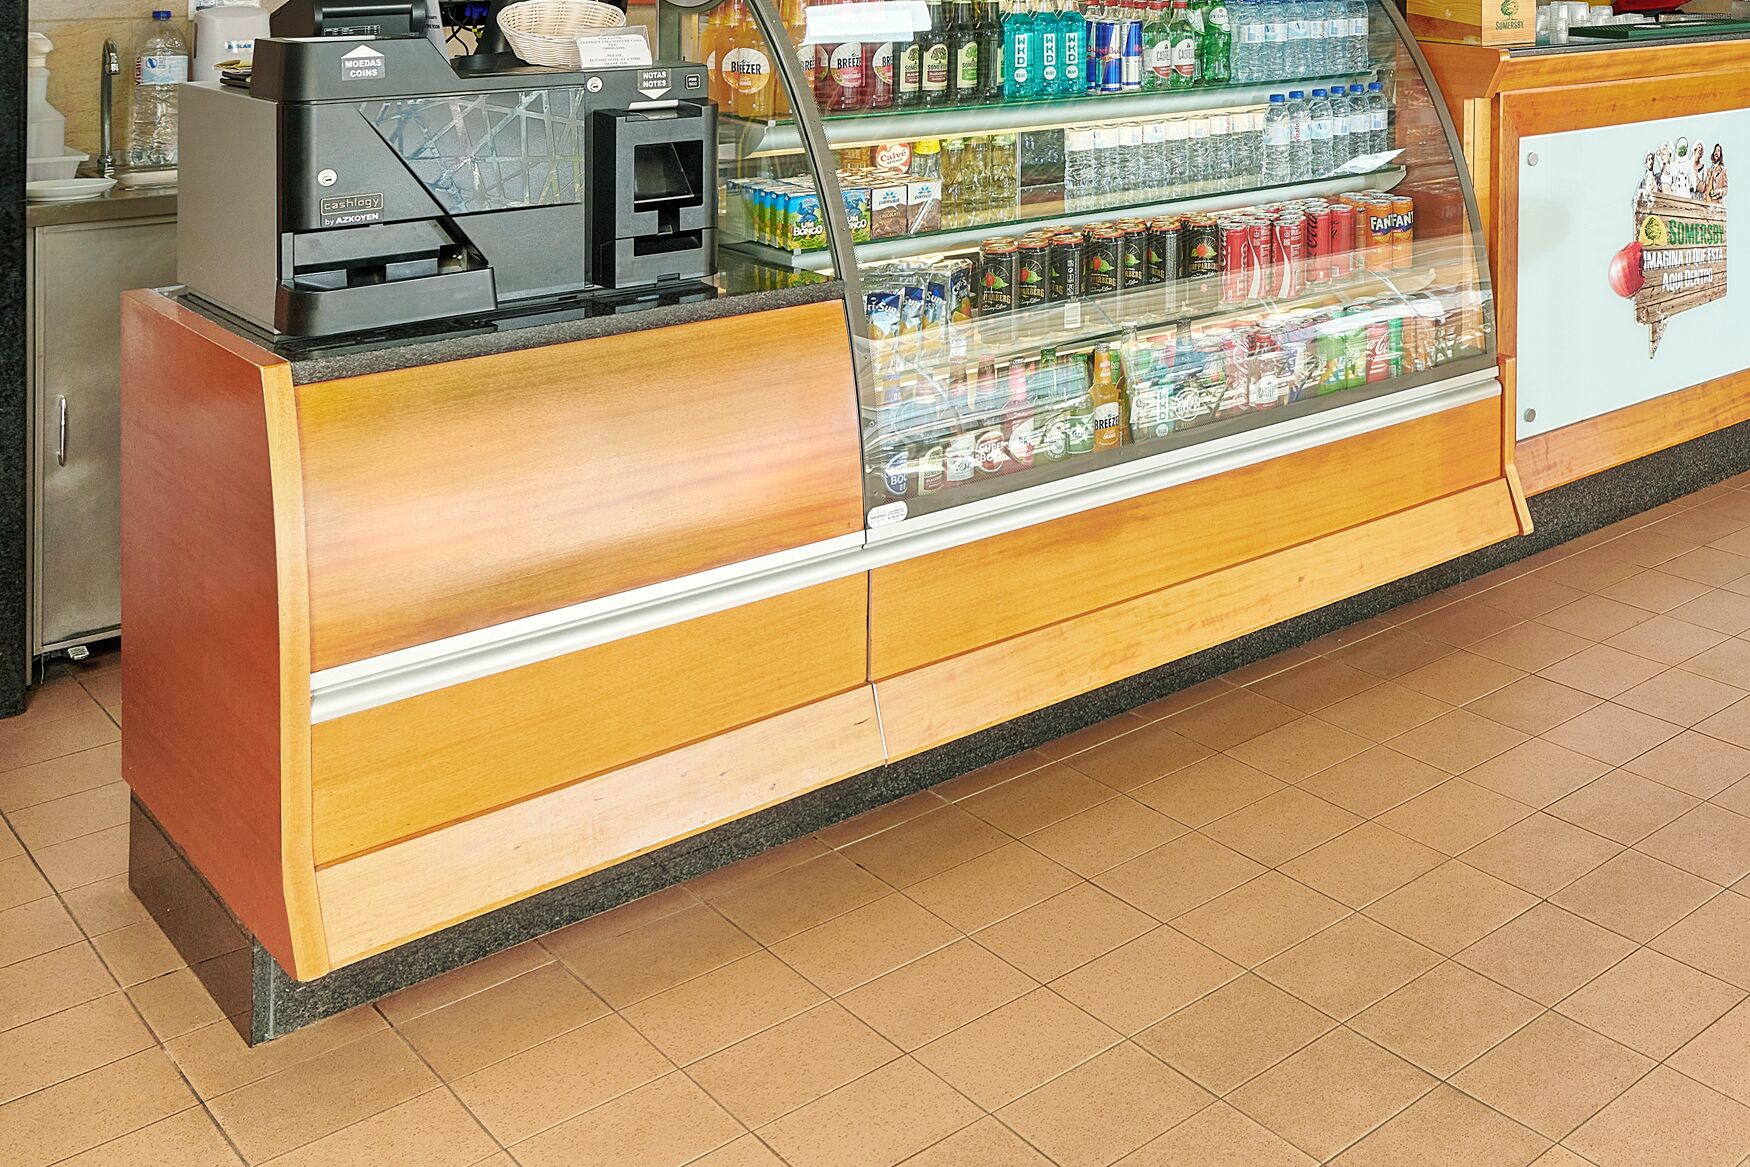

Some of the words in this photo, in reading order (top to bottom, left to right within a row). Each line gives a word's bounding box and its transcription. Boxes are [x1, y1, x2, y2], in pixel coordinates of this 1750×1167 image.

[1495, 20, 1524, 30] SOMERSBY
[1017, 37, 1026, 65] WKD
[1046, 36, 1054, 62] WKD
[1068, 35, 1077, 61] WKD
[345, 59, 382, 69] MOEDAS
[350, 69, 378, 78] COINS
[643, 79, 667, 88] NOTES
[880, 149, 907, 162] Calvé
[324, 198, 379, 210] cashlogy
[879, 198, 900, 206] parmalat
[336, 213, 379, 224] AZKOYEN
[793, 225, 822, 236] BONGO
[1668, 219, 1724, 245] SOMERSBY
[1643, 250, 1683, 270] IMAGINA
[1686, 250, 1691, 263] O
[1694, 248, 1706, 267] QUE
[1662, 272, 1683, 292] AQUI
[1684, 268, 1712, 288] DENTRO
